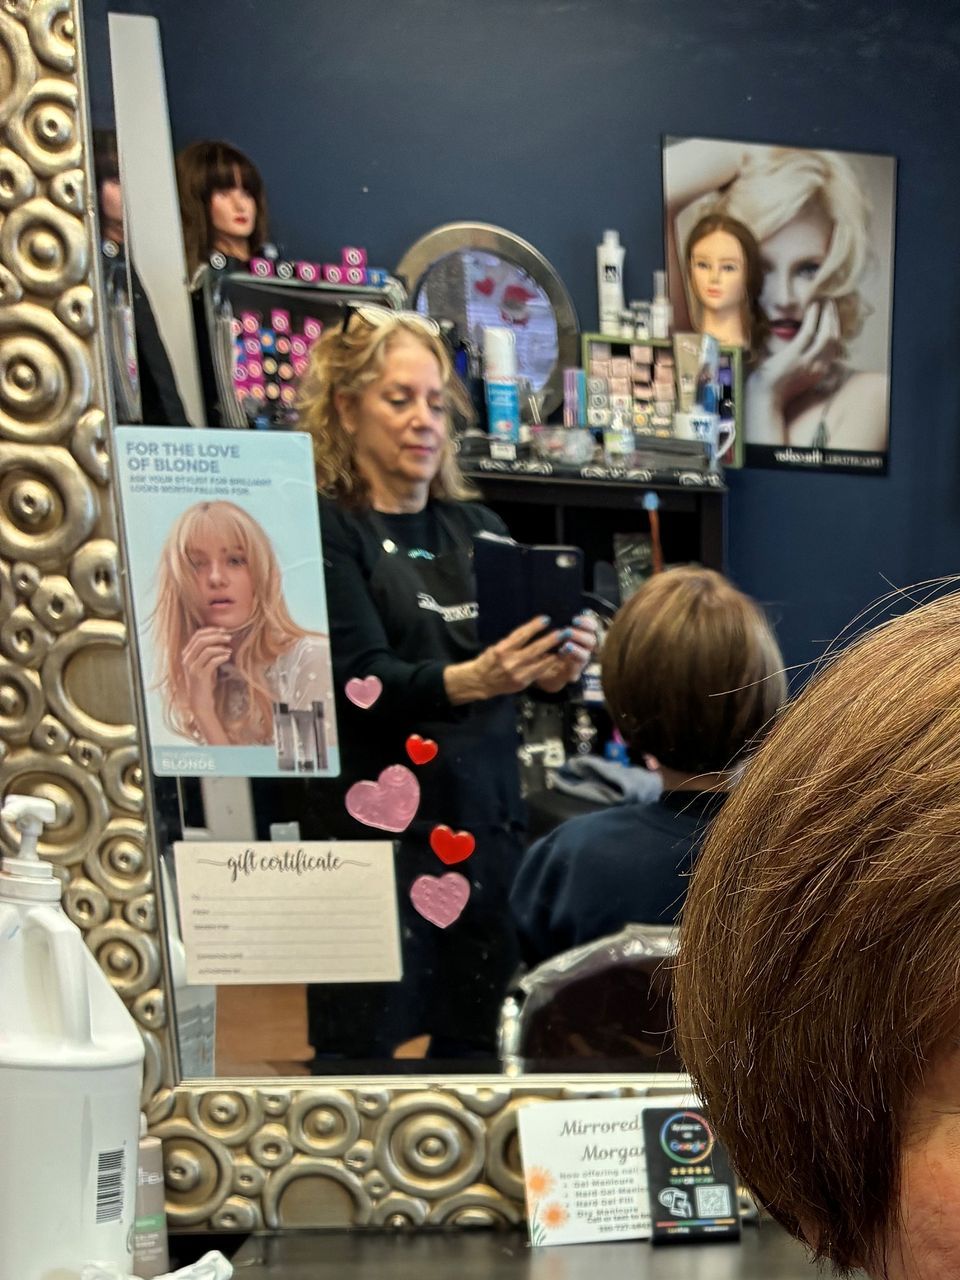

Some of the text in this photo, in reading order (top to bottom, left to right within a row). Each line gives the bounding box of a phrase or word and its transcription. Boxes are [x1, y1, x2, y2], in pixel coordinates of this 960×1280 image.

[126, 441, 240, 458] FOR THE LOVE
[128, 458, 221, 474] OF BLONDE
[162, 758, 217, 770] BLONDE
[227, 848, 343, 883] gift certificate
[560, 1115, 640, 1137] Mirrored
[582, 1168, 619, 1177] offering
[591, 1178, 634, 1187] Manicure
